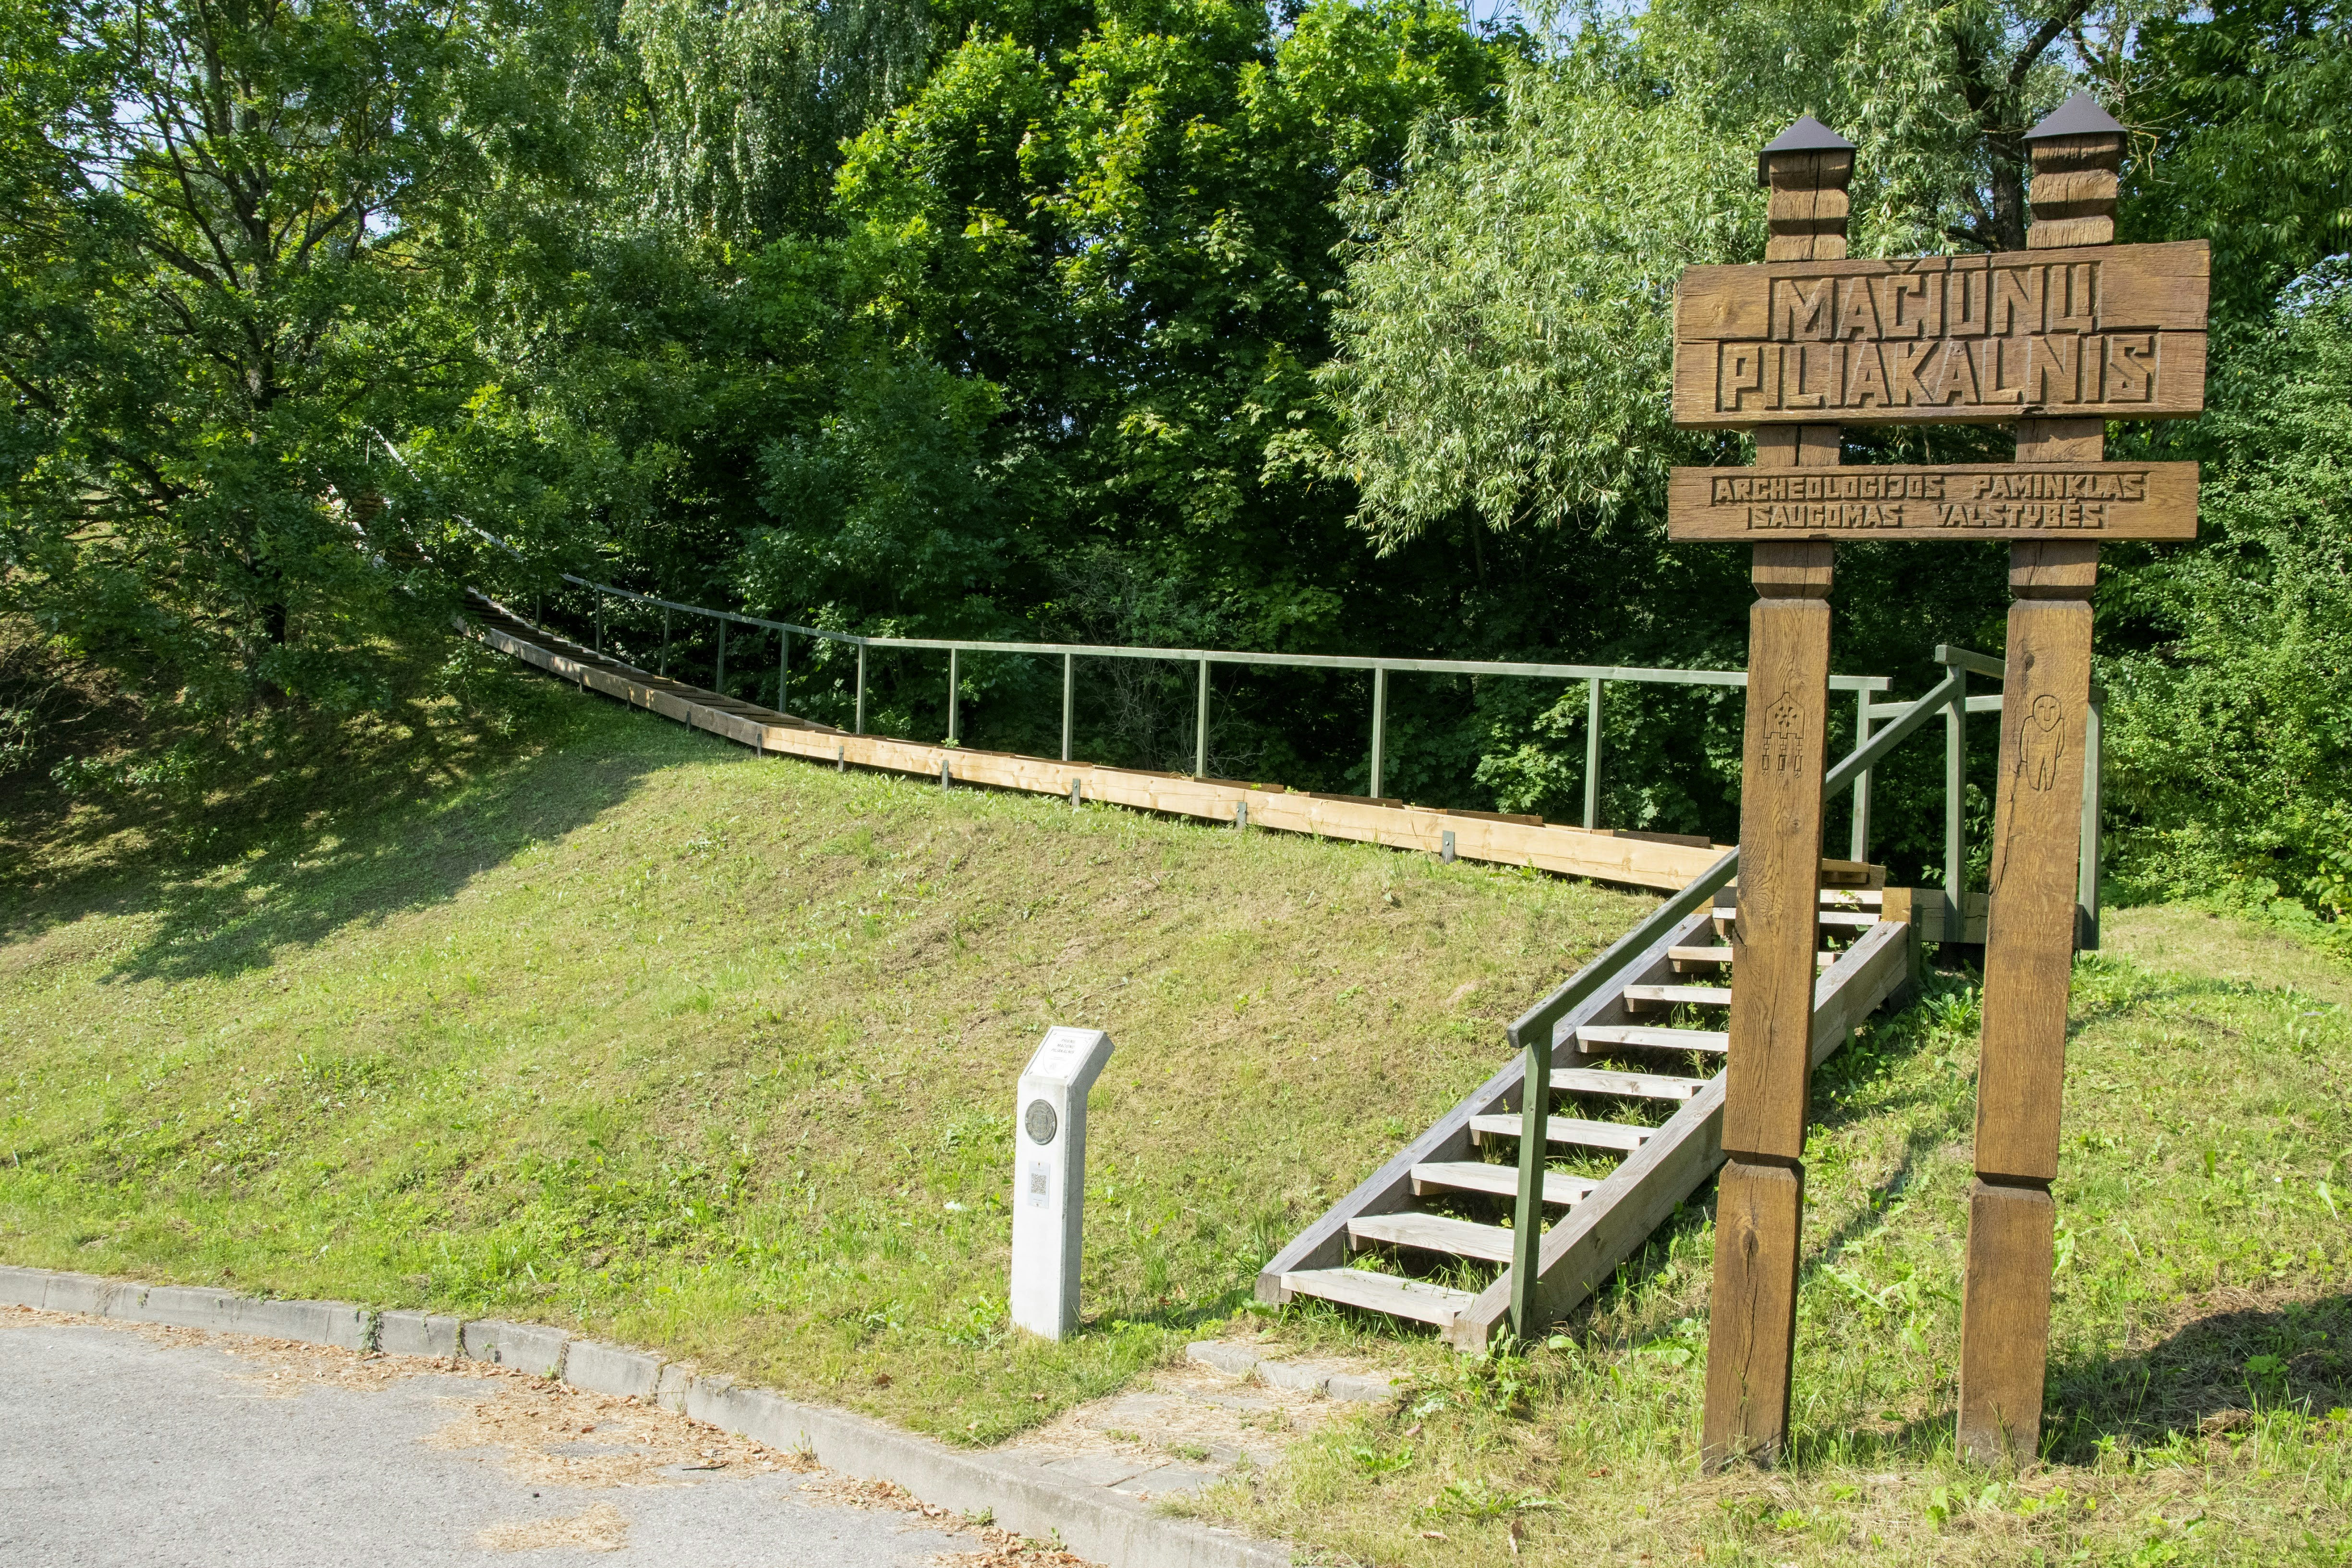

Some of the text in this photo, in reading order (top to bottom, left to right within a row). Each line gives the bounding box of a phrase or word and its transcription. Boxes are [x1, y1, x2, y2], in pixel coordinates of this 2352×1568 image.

[1723, 335, 2154, 411] PILIAKALNIS
[1714, 473, 2144, 501] ARCHEOLOGIJOS PAMINKLAS
[1750, 506, 1902, 528] SAUGOMAS
